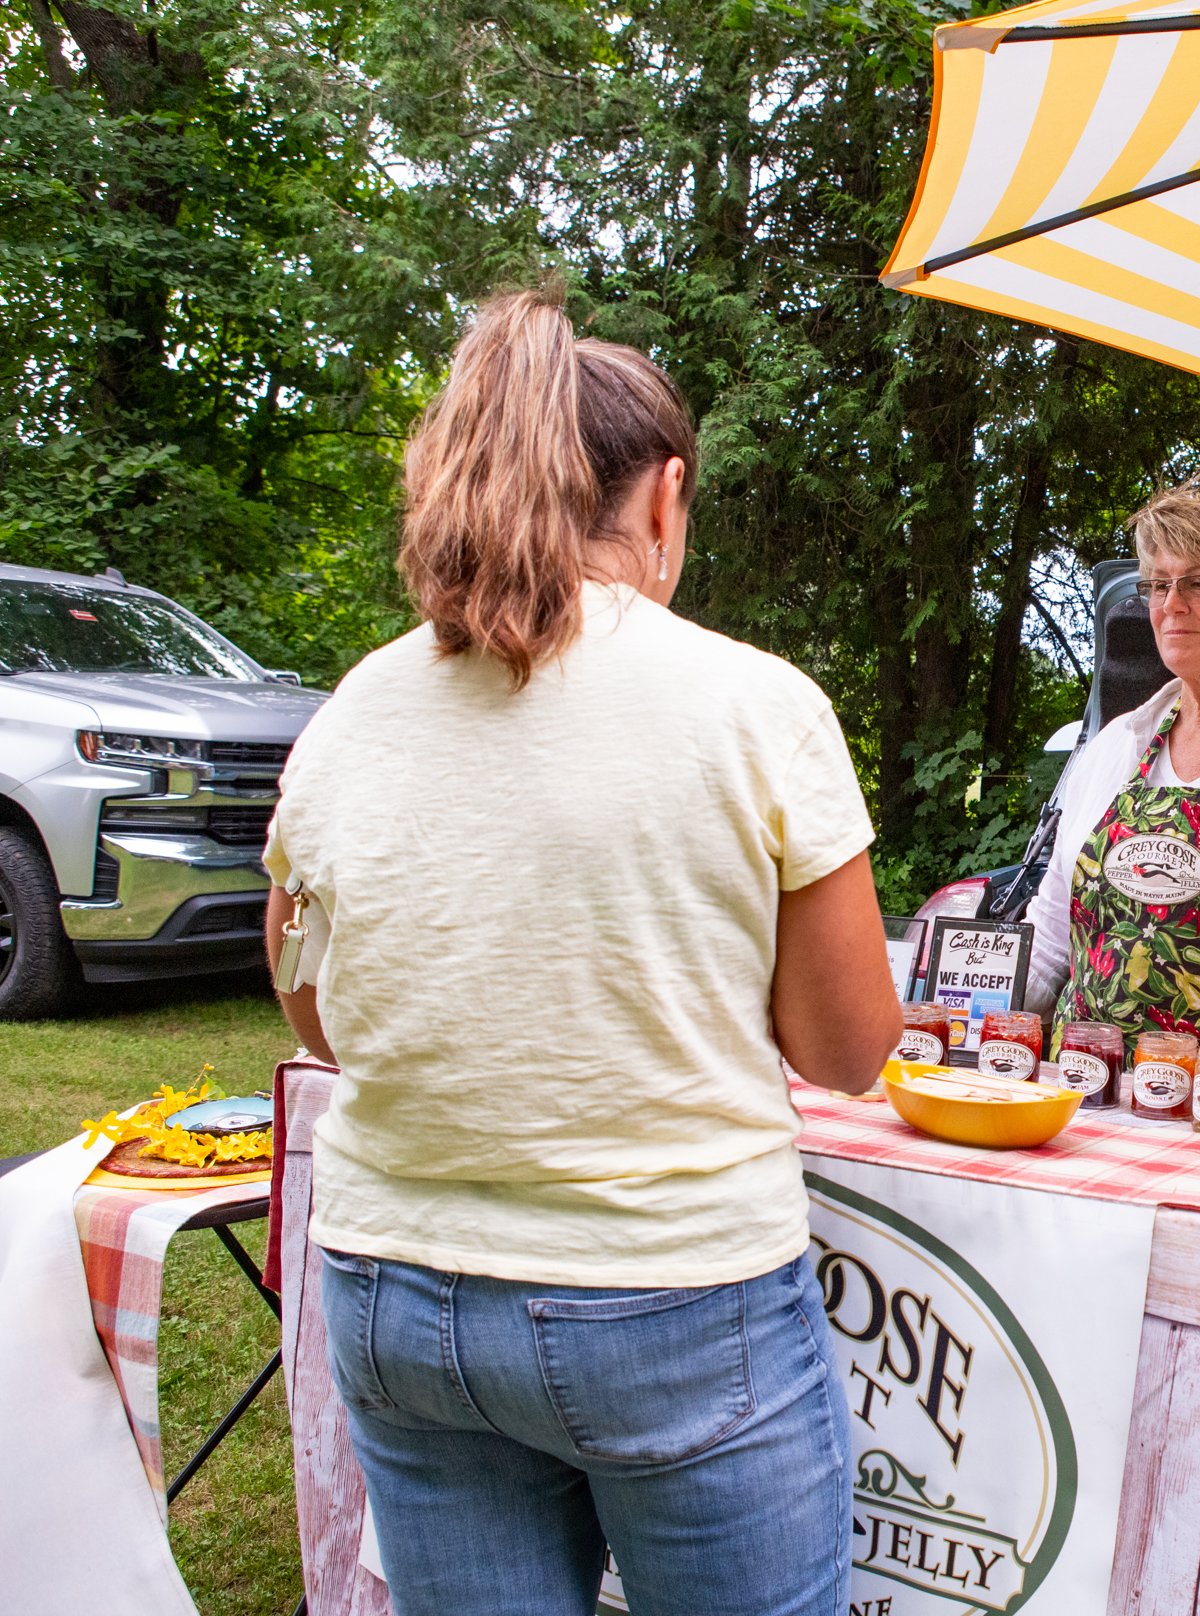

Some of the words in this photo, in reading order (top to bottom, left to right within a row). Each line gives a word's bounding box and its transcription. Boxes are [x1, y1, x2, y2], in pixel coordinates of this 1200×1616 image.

[1117, 841, 1157, 862] GREY
[1156, 840, 1198, 873] GOOSE
[1127, 852, 1185, 870] GOURMET
[1107, 870, 1133, 880] PEPPER
[1164, 890, 1187, 899] MAINE
[949, 932, 980, 949] Cash
[980, 935, 991, 948] is
[991, 933, 1014, 955] King
[965, 951, 987, 965] But
[939, 971, 959, 986] WE
[961, 972, 1013, 990] ACCEPT
[943, 997, 965, 1009] VISA
[1001, 1045, 1030, 1063] GOOSE
[1073, 1055, 1100, 1074] GOOSE
[1157, 1067, 1186, 1085] GOOSE
[864, 1513, 1005, 1591] JELLY
